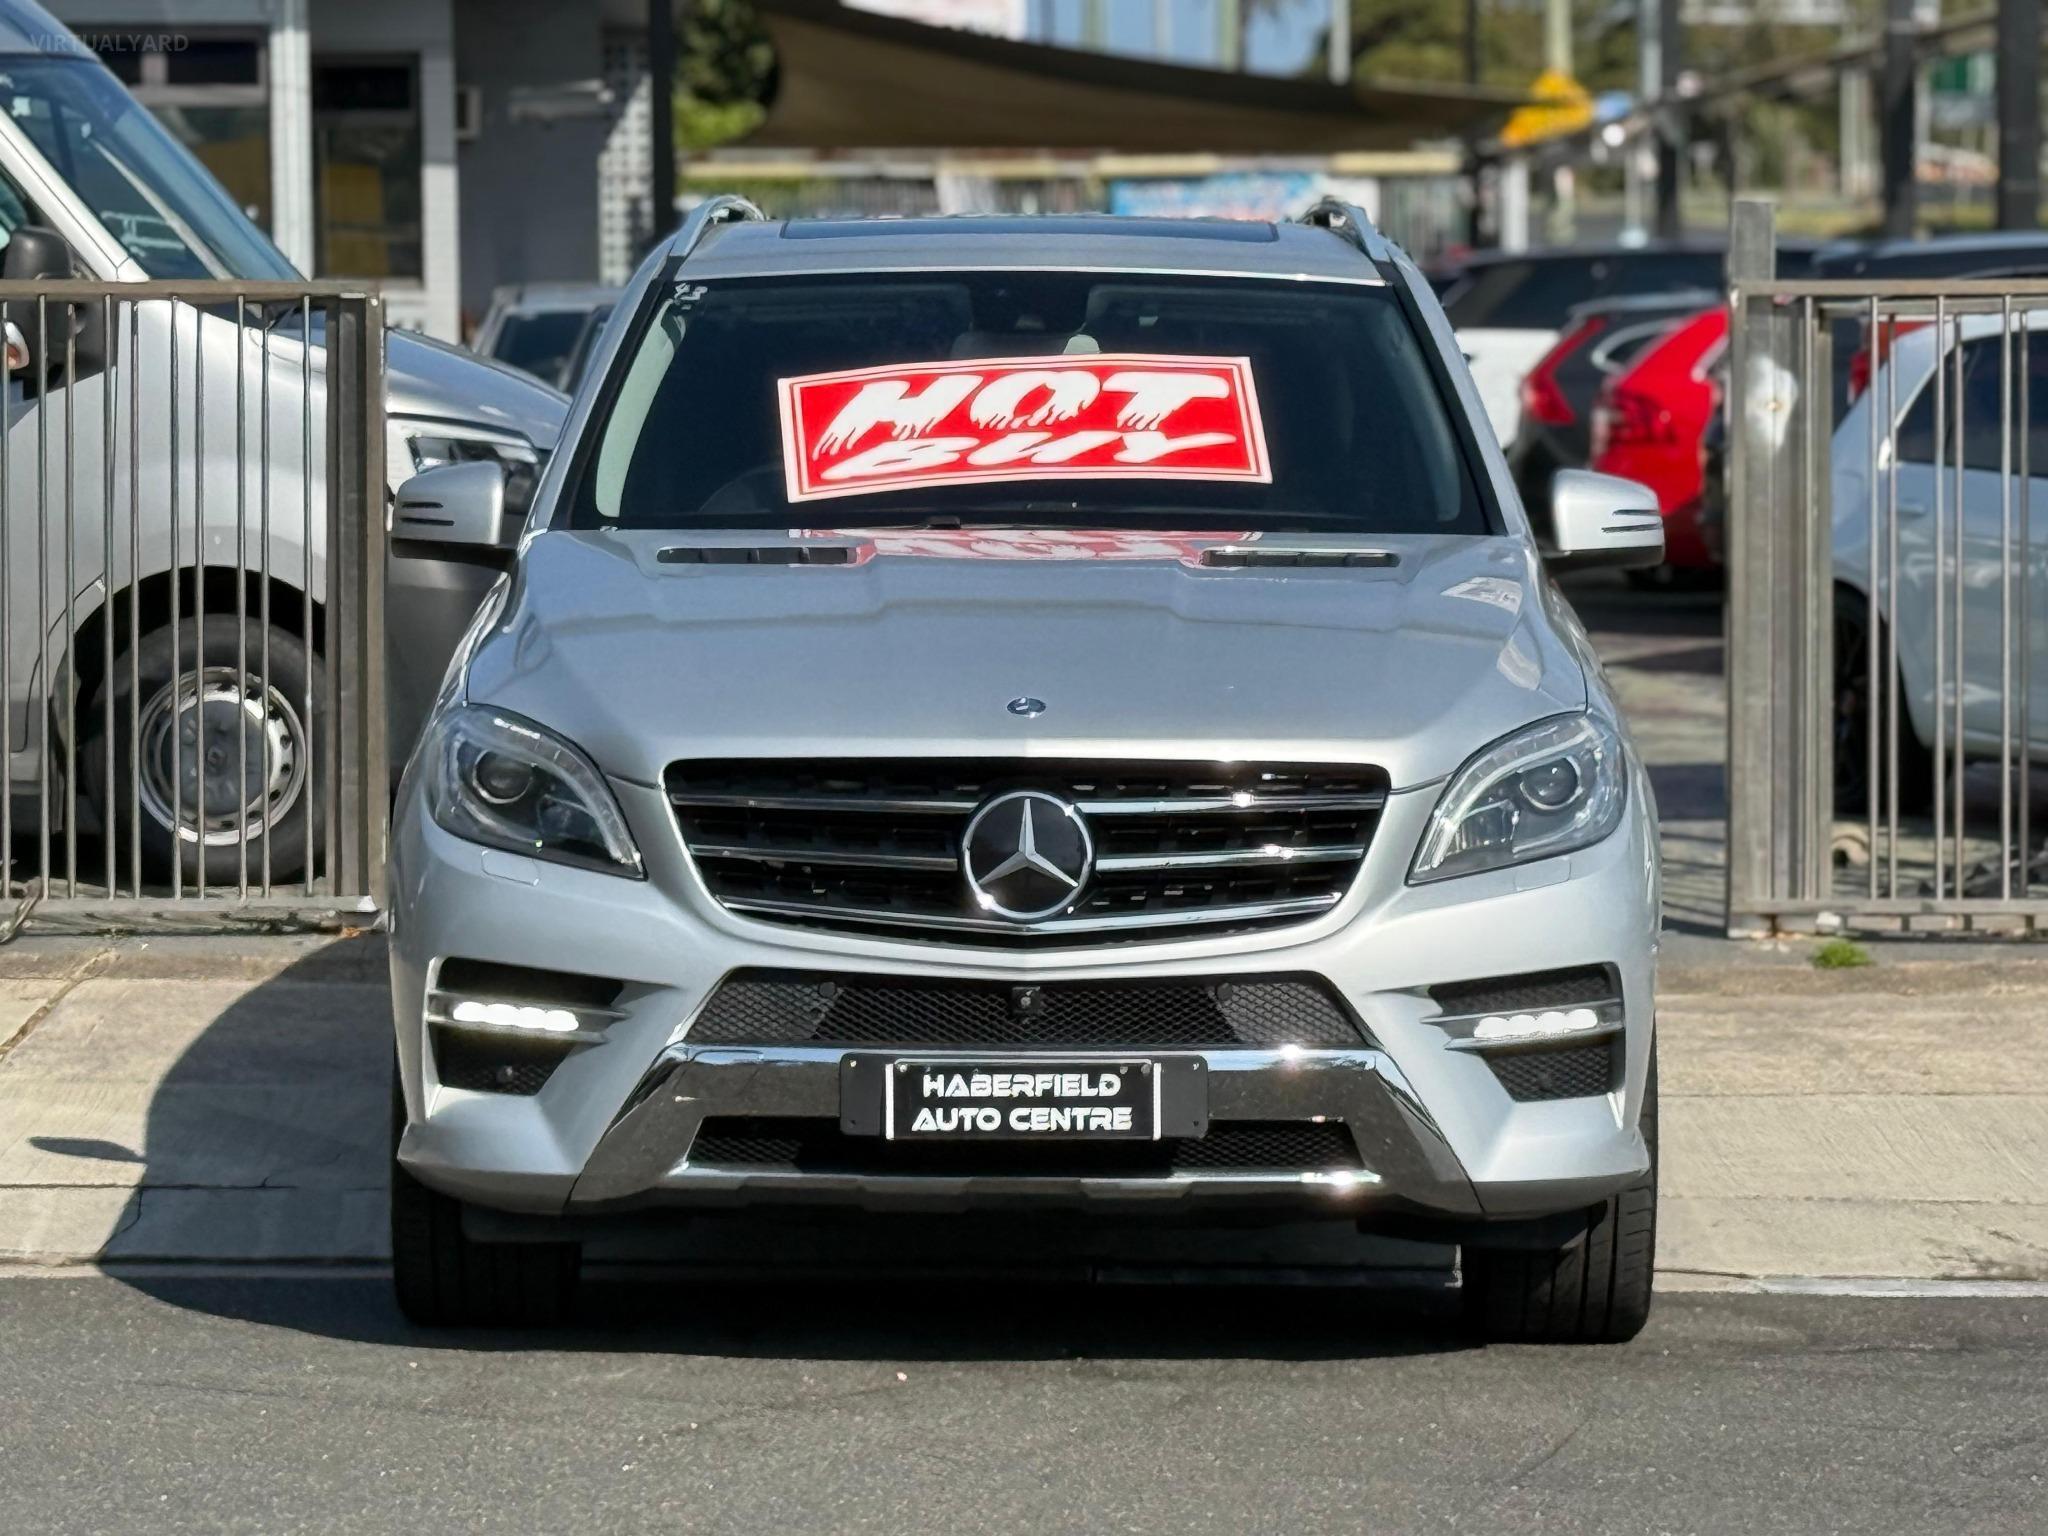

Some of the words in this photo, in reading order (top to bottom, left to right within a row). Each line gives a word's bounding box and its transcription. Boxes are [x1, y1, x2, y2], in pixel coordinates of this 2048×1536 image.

[812, 370, 1230, 462] HOT
[820, 431, 1237, 480] BUY
[922, 1073, 1121, 1099] HABERFIELD
[911, 1107, 1002, 1132] AUTO
[1008, 1107, 1133, 1132] CENTRE
